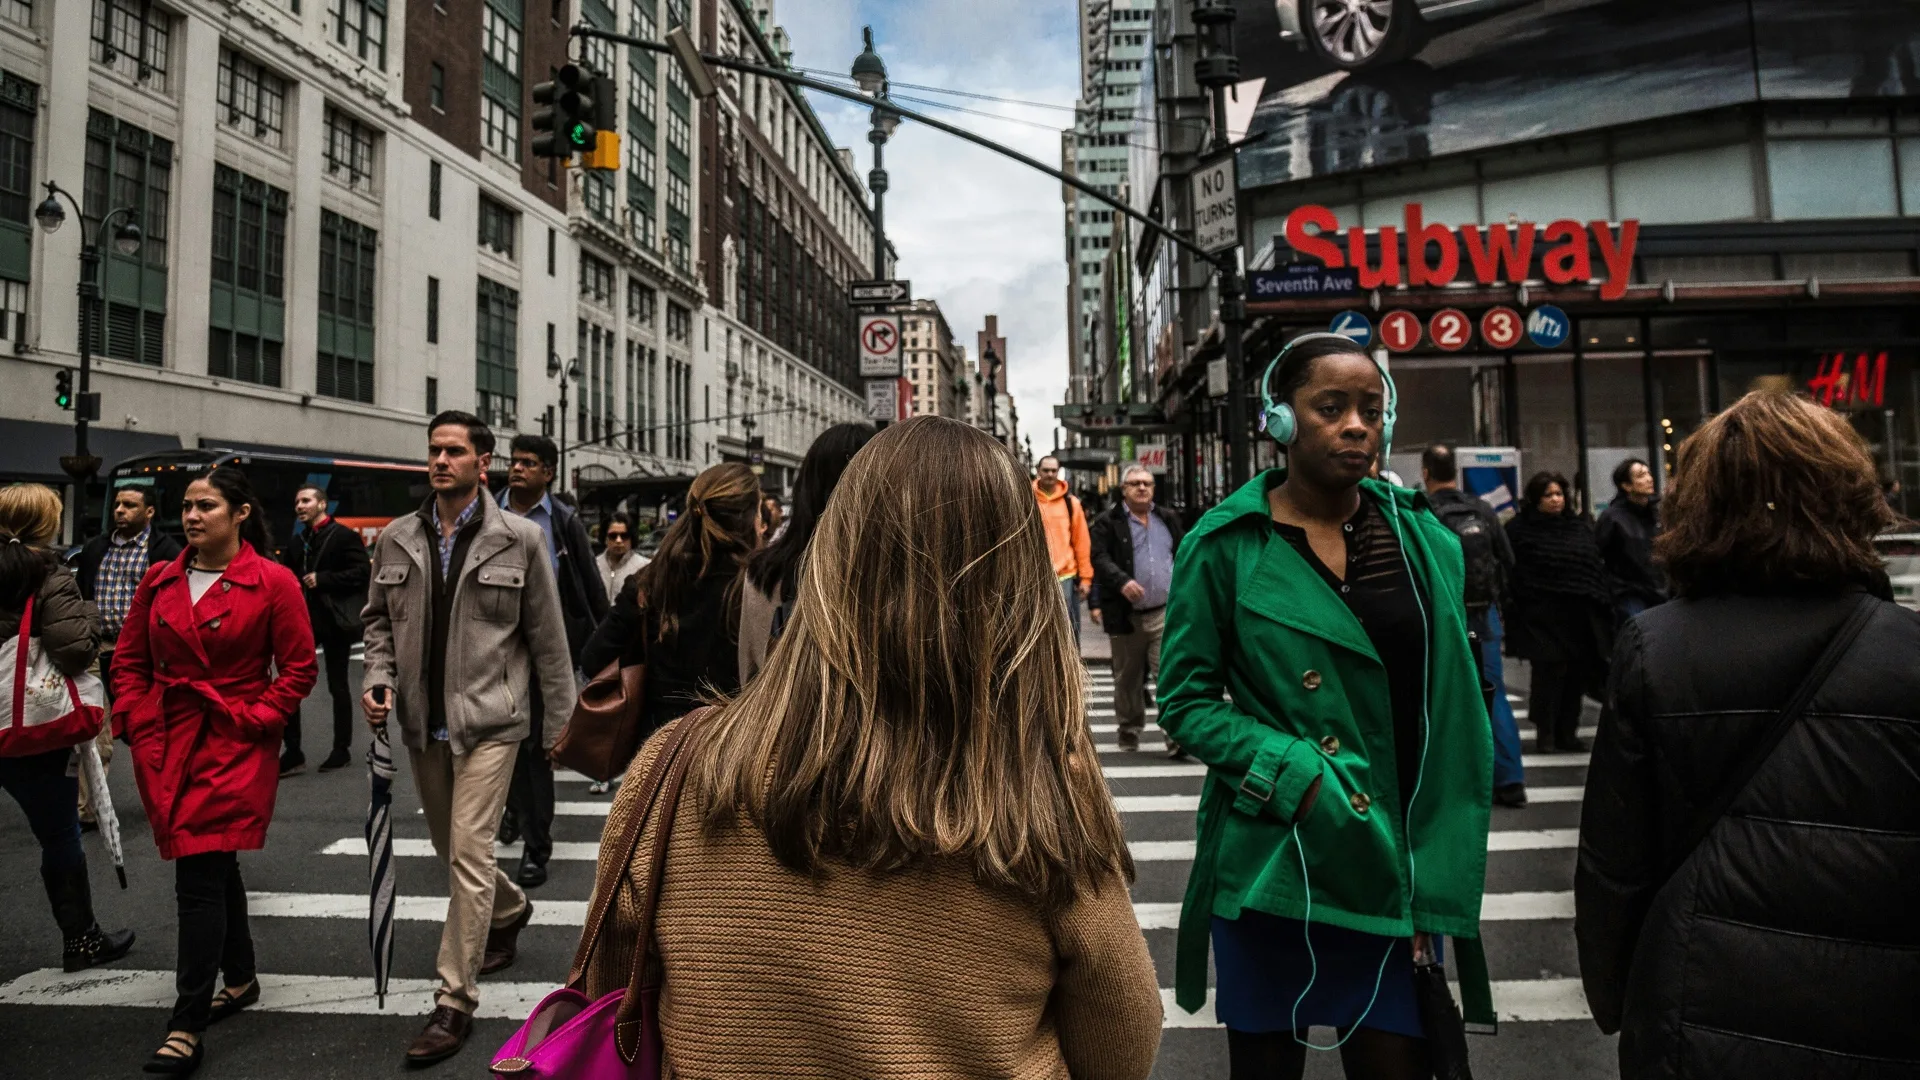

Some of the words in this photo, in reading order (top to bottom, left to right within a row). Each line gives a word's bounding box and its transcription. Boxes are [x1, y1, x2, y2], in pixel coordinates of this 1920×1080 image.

[1202, 169, 1225, 199] NO
[1196, 198, 1236, 226] TURNS
[1282, 203, 1640, 300] Subway
[1256, 275, 1319, 294] Seventh
[1323, 275, 1352, 291] Ave
[1391, 316, 1407, 345] 1
[1439, 315, 1462, 344] 2
[1491, 313, 1514, 342] 3
[1528, 309, 1561, 337] MTA
